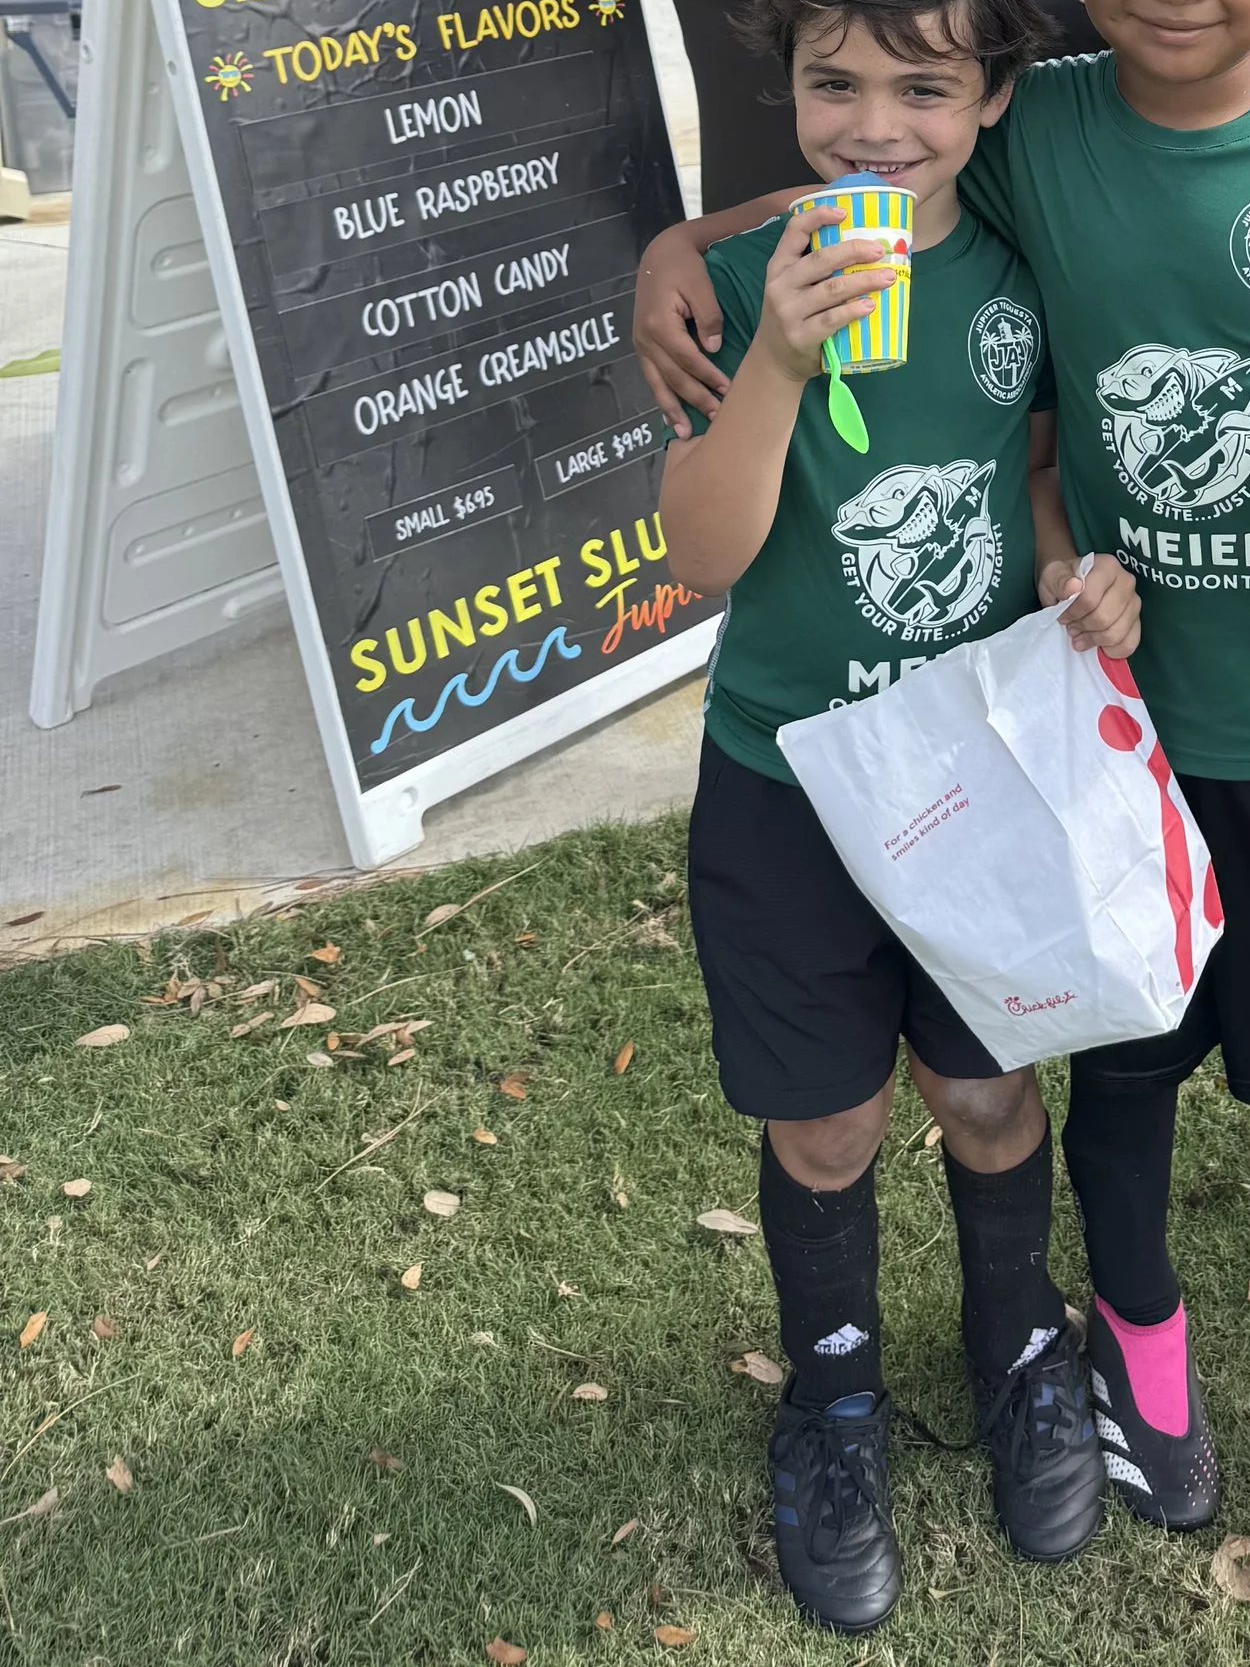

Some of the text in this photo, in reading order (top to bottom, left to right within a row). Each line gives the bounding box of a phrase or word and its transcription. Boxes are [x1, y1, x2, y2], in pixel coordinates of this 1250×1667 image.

[264, 23, 417, 86] TODAY'S
[384, 90, 483, 144] LEMON
[333, 152, 560, 240] BLUE RASPBERRY
[362, 243, 571, 337] COTTON CANDY
[975, 303, 999, 334] JUPITER
[354, 311, 620, 435] ORANGE CREAMSICLE
[979, 373, 1007, 400] ATHLETIC
[555, 441, 608, 483] LARGE
[1101, 417, 1117, 454] GET
[1112, 459, 1149, 505] YOUR
[396, 504, 450, 540] SMALL
[351, 556, 561, 693] SUNSET
[841, 552, 861, 588] GET
[854, 592, 898, 636] YOUR
[884, 782, 963, 850] For a chicken and
[891, 797, 970, 861] smiles kind of day
